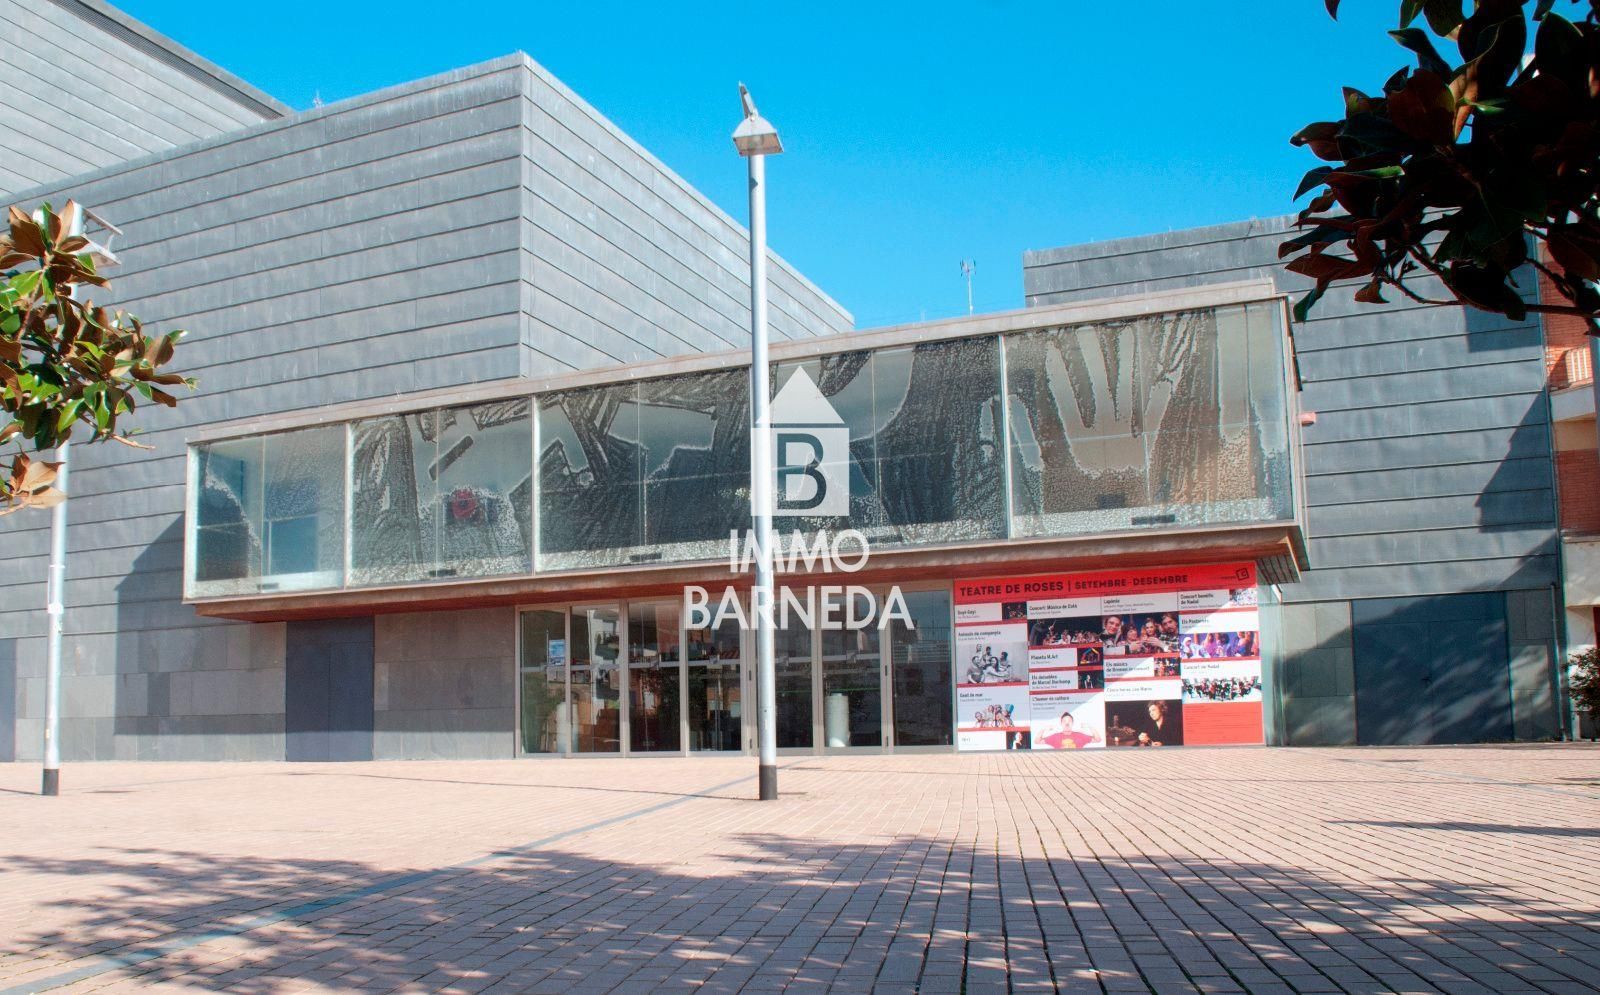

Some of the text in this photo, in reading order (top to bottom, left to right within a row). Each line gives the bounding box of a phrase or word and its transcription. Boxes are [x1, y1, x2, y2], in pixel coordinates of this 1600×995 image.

[960, 574, 1188, 597] TEATRE DE ROSES SETEMBRE DESEMBRE
